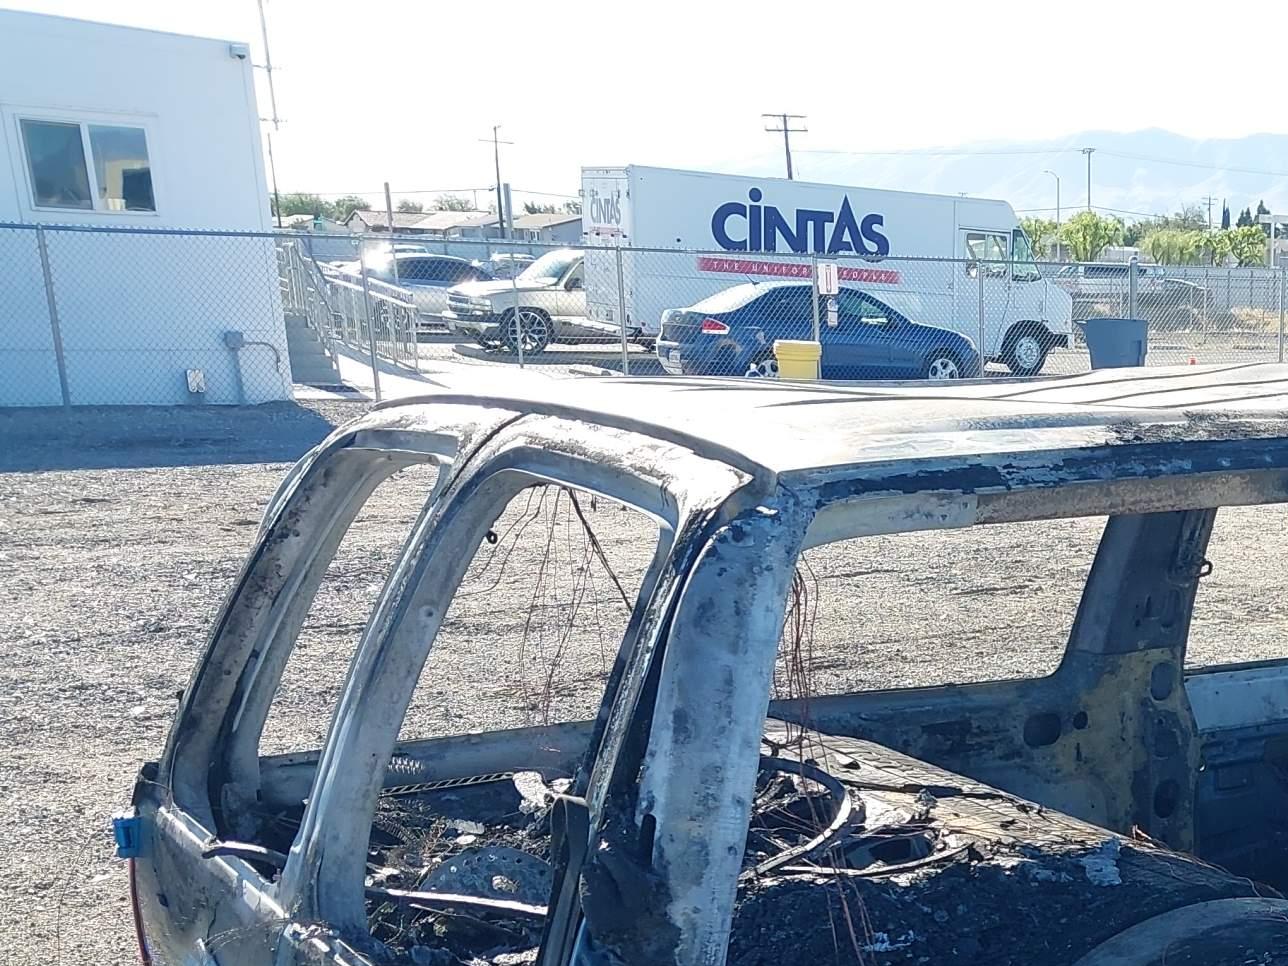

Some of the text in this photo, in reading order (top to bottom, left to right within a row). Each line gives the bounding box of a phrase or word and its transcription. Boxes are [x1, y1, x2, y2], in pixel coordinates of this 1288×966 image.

[713, 261, 887, 281] THE UNIFOR EOPLE
